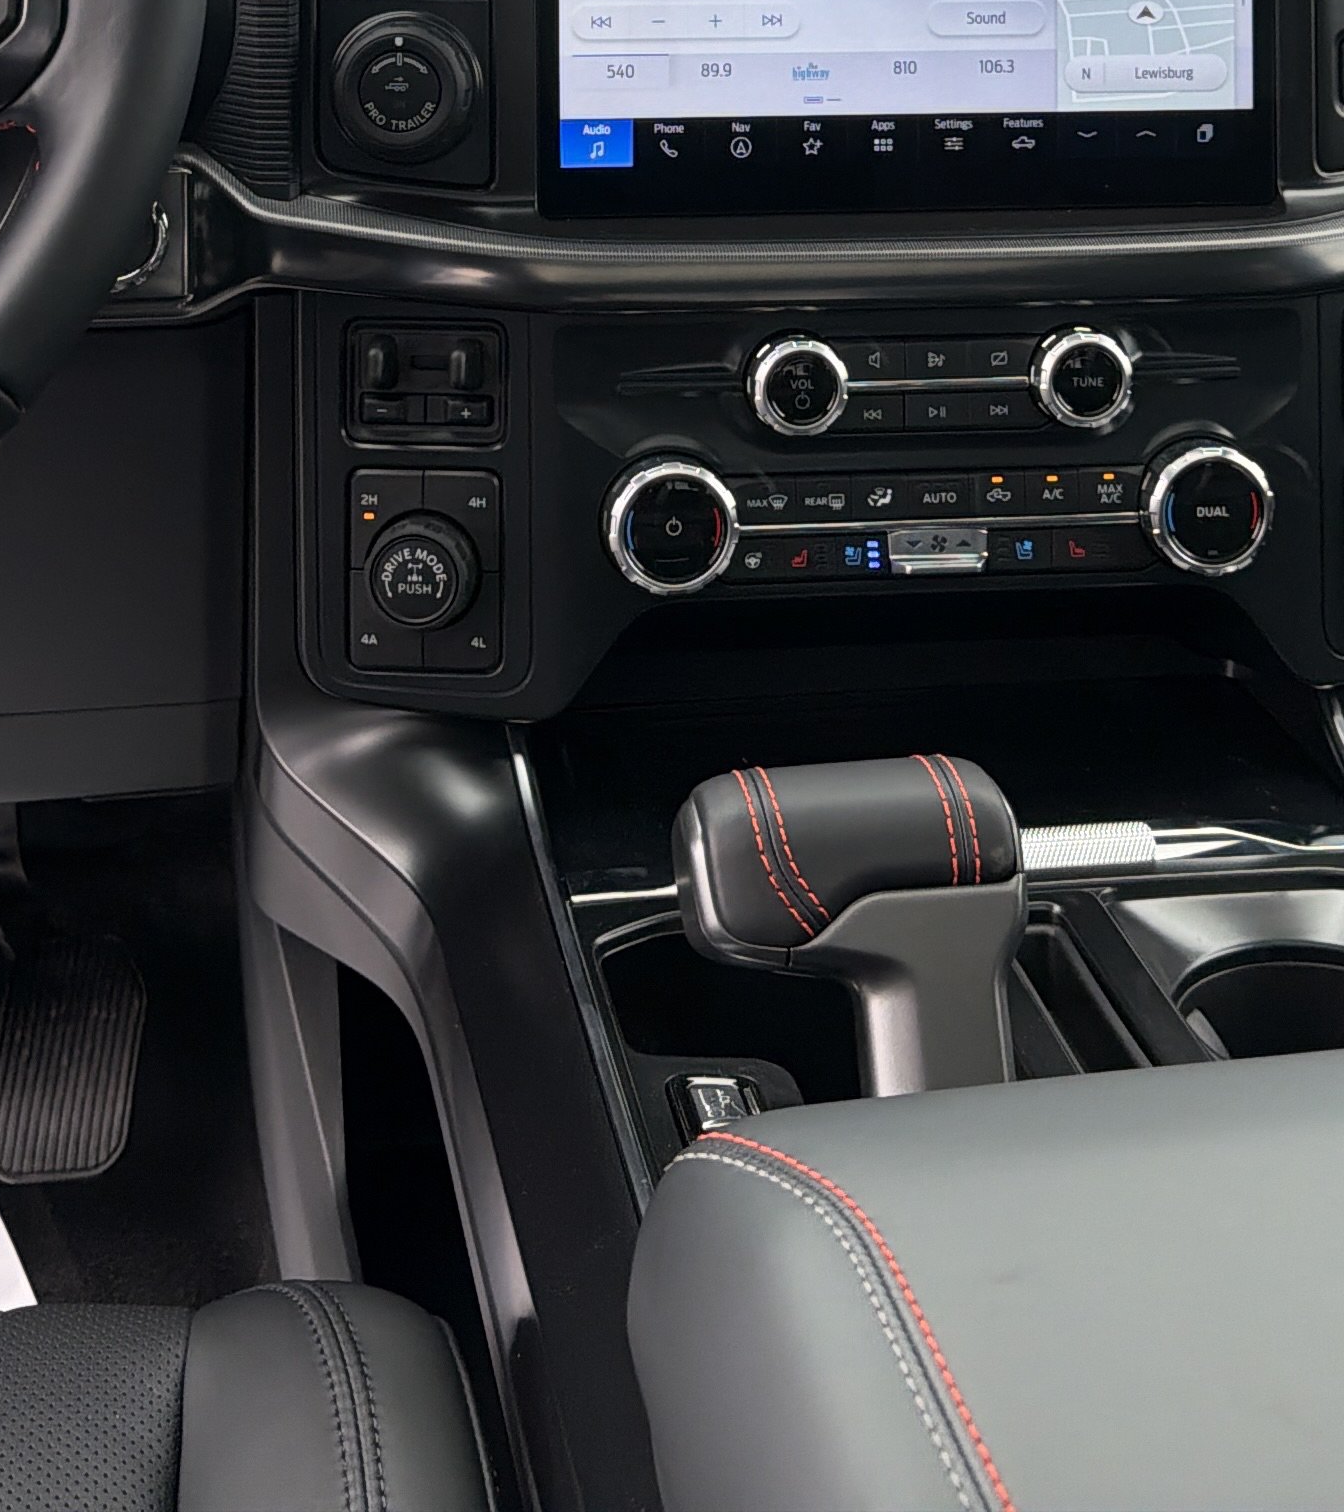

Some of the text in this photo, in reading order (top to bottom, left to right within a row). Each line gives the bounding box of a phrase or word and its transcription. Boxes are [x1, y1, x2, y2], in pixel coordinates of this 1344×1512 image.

[966, 11, 1007, 25] Sound
[606, 64, 635, 79] 540
[700, 63, 732, 77] 89.9
[893, 60, 917, 75] 810
[979, 59, 1015, 74] 106.3
[1081, 67, 1194, 81] N Lewisburg
[364, 101, 436, 131] PRO TRAILER
[582, 123, 611, 136] Audio
[654, 123, 685, 134] Phone
[731, 122, 751, 133] Nav
[803, 121, 821, 132] Fav
[871, 119, 896, 131] Apps
[934, 119, 974, 131] Settings
[1003, 118, 1044, 129] Features
[789, 378, 814, 390] VOL
[1071, 376, 1105, 388] TUNE
[1042, 488, 1065, 501] A/C
[1097, 483, 1123, 494] MAX
[360, 494, 378, 506] 2H
[468, 497, 486, 509] 4H
[747, 499, 768, 509] MAX
[805, 496, 828, 507] REAR
[922, 492, 957, 504] AUTO
[1100, 493, 1122, 504] A/C
[1196, 506, 1230, 518] DUAL
[381, 548, 447, 582] DRIVE MODE
[397, 583, 432, 595] PUSH
[360, 633, 378, 646] 4A
[470, 637, 486, 649] 4L
